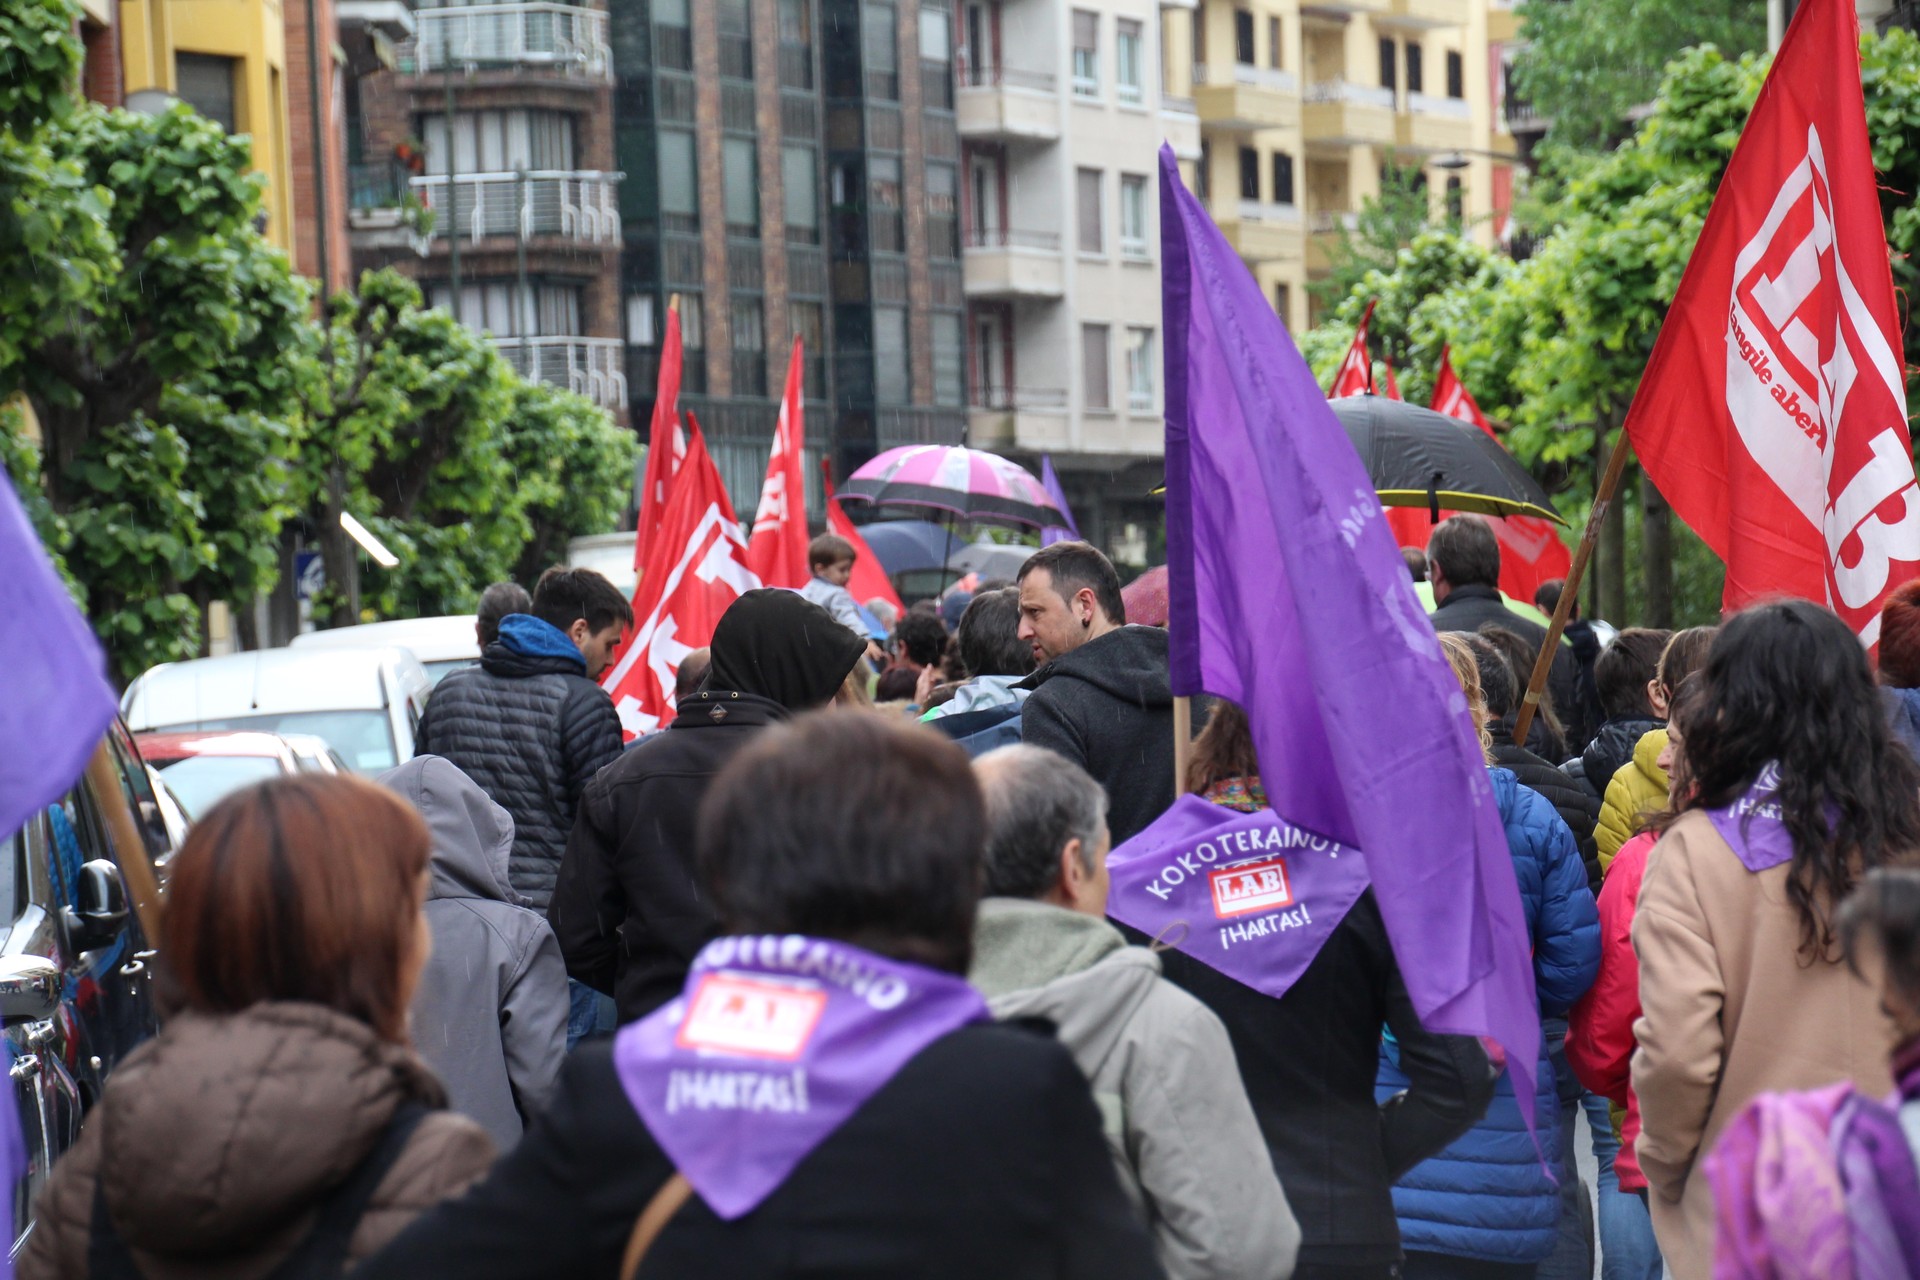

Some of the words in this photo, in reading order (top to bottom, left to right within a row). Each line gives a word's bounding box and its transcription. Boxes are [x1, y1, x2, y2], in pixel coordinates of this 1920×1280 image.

[1729, 302, 1773, 385] langile
[1770, 383, 1823, 450] aber
[1219, 870, 1282, 902] LAB
